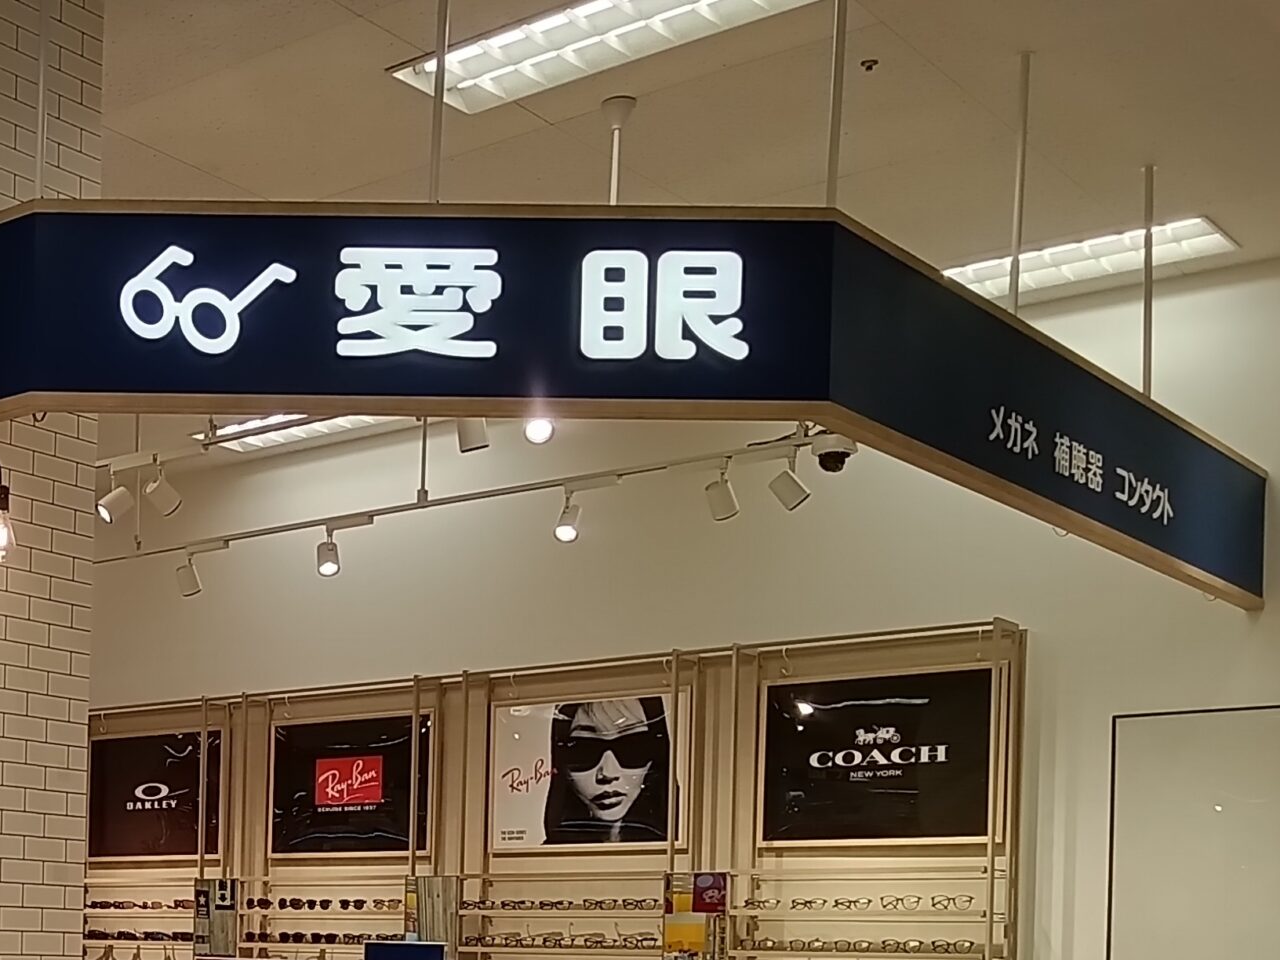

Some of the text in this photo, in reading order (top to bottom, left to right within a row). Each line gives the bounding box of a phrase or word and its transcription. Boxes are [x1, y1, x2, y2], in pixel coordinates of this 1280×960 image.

[989, 405, 1174, 525] メガネ 補聴器 コンタクト
[809, 745, 949, 768] COACH
[849, 769, 902, 779] NEW YORK
[126, 799, 178, 811] OAKLEY
